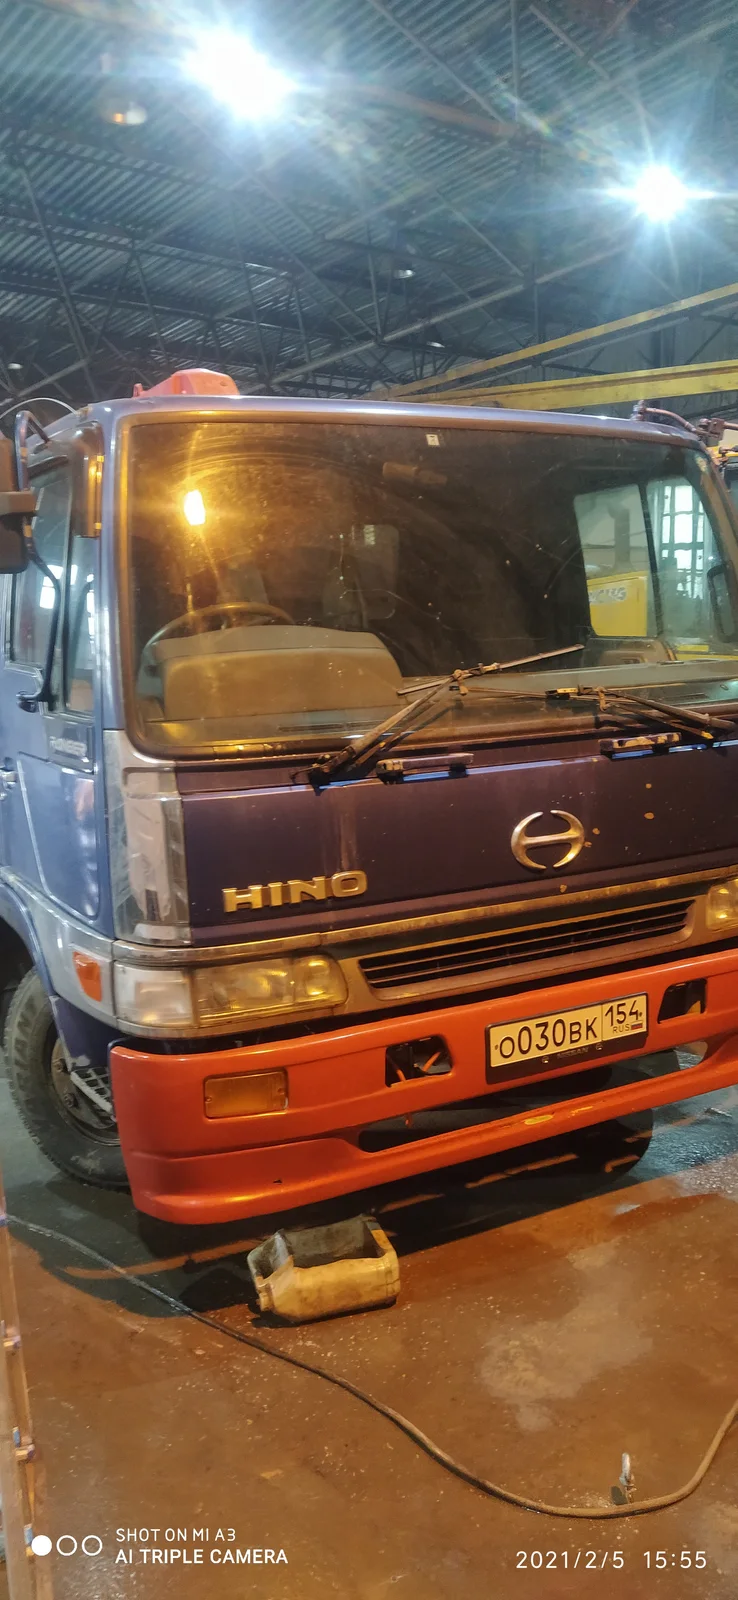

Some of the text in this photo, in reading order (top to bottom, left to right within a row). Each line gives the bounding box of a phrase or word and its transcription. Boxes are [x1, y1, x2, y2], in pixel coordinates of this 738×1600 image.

[222, 870, 367, 913] HINO
[604, 1000, 640, 1027] 154
[612, 1023, 631, 1034] RUS
